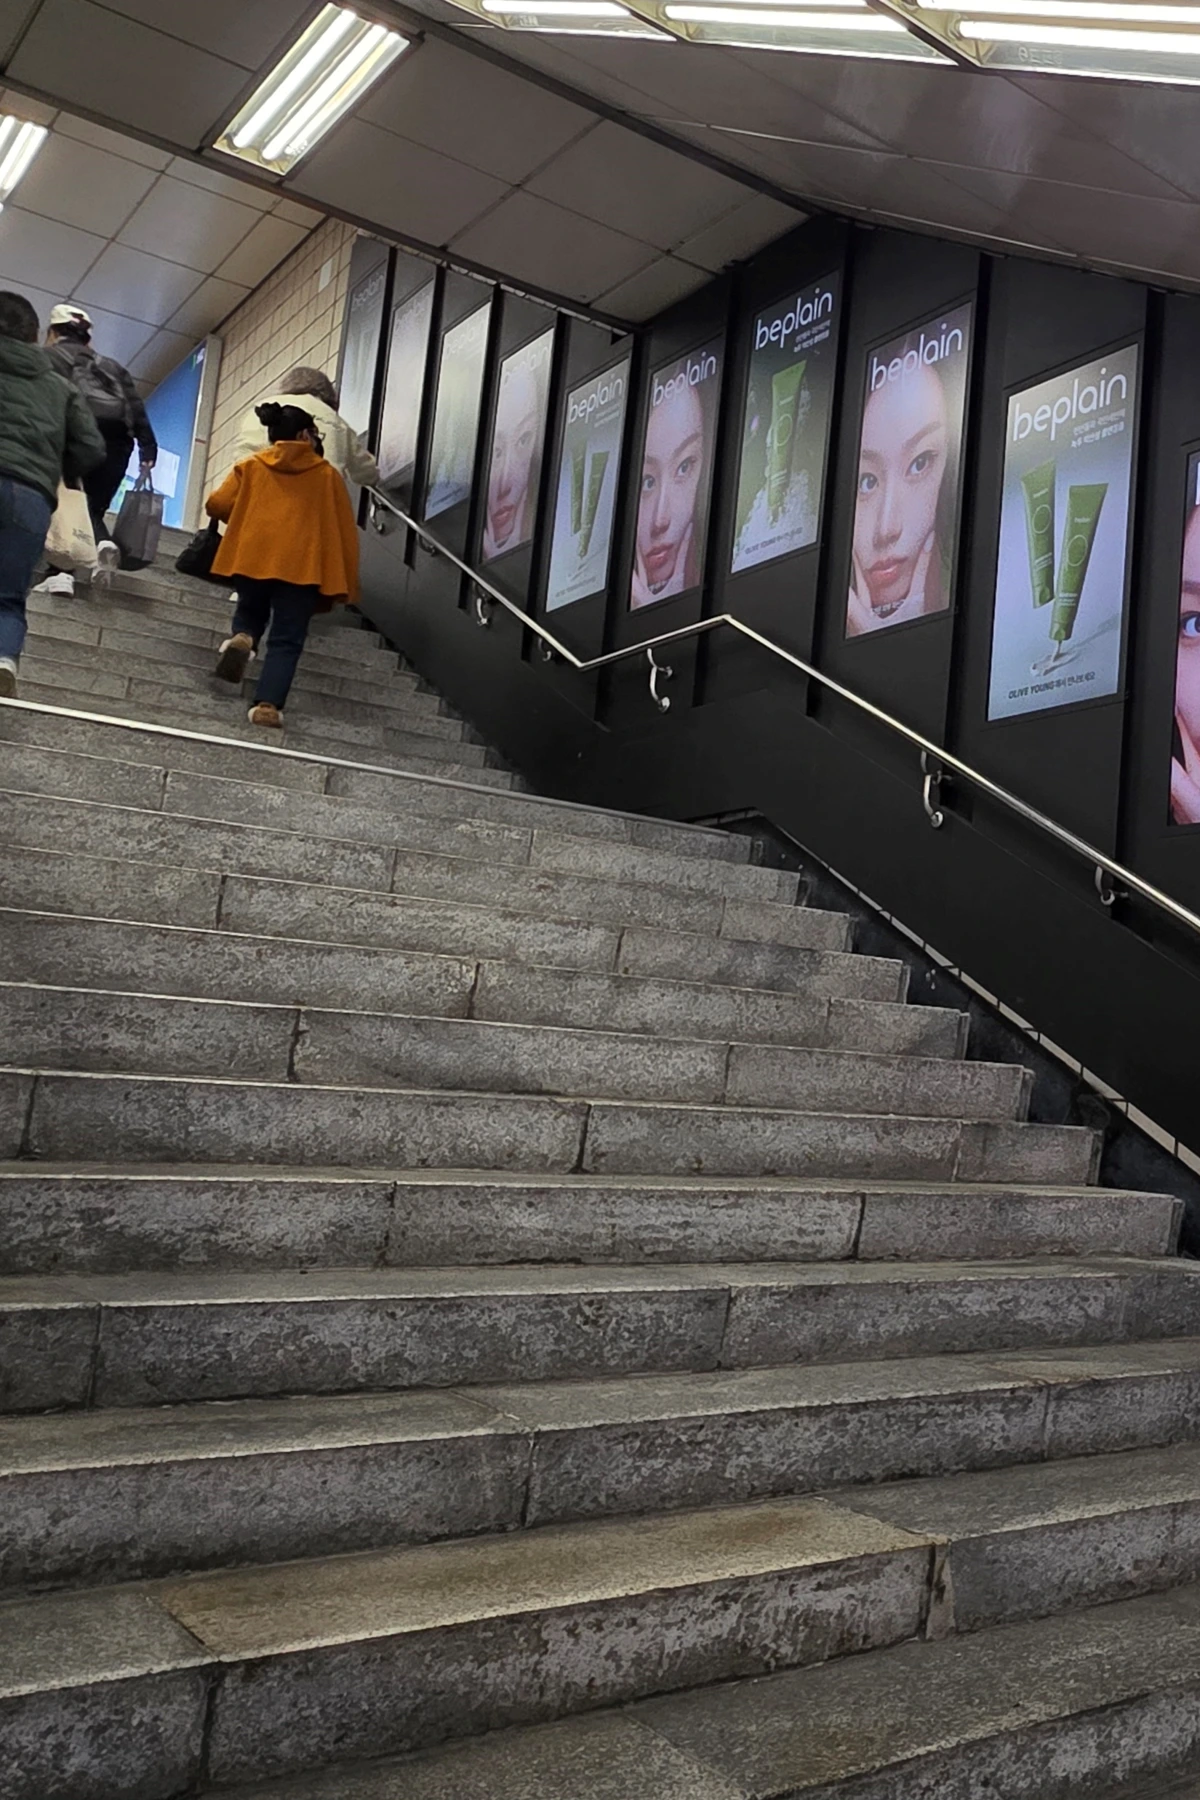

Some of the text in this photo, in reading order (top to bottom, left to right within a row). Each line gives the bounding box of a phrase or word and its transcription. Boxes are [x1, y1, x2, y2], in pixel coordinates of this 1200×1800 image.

[755, 287, 832, 351] beplain
[653, 351, 716, 407] beplain
[871, 323, 962, 391] beplain
[568, 374, 622, 424] beplain
[1013, 367, 1127, 441] beplain
[1008, 687, 1029, 699] OLIVE
[1031, 681, 1054, 694] YOUNG
